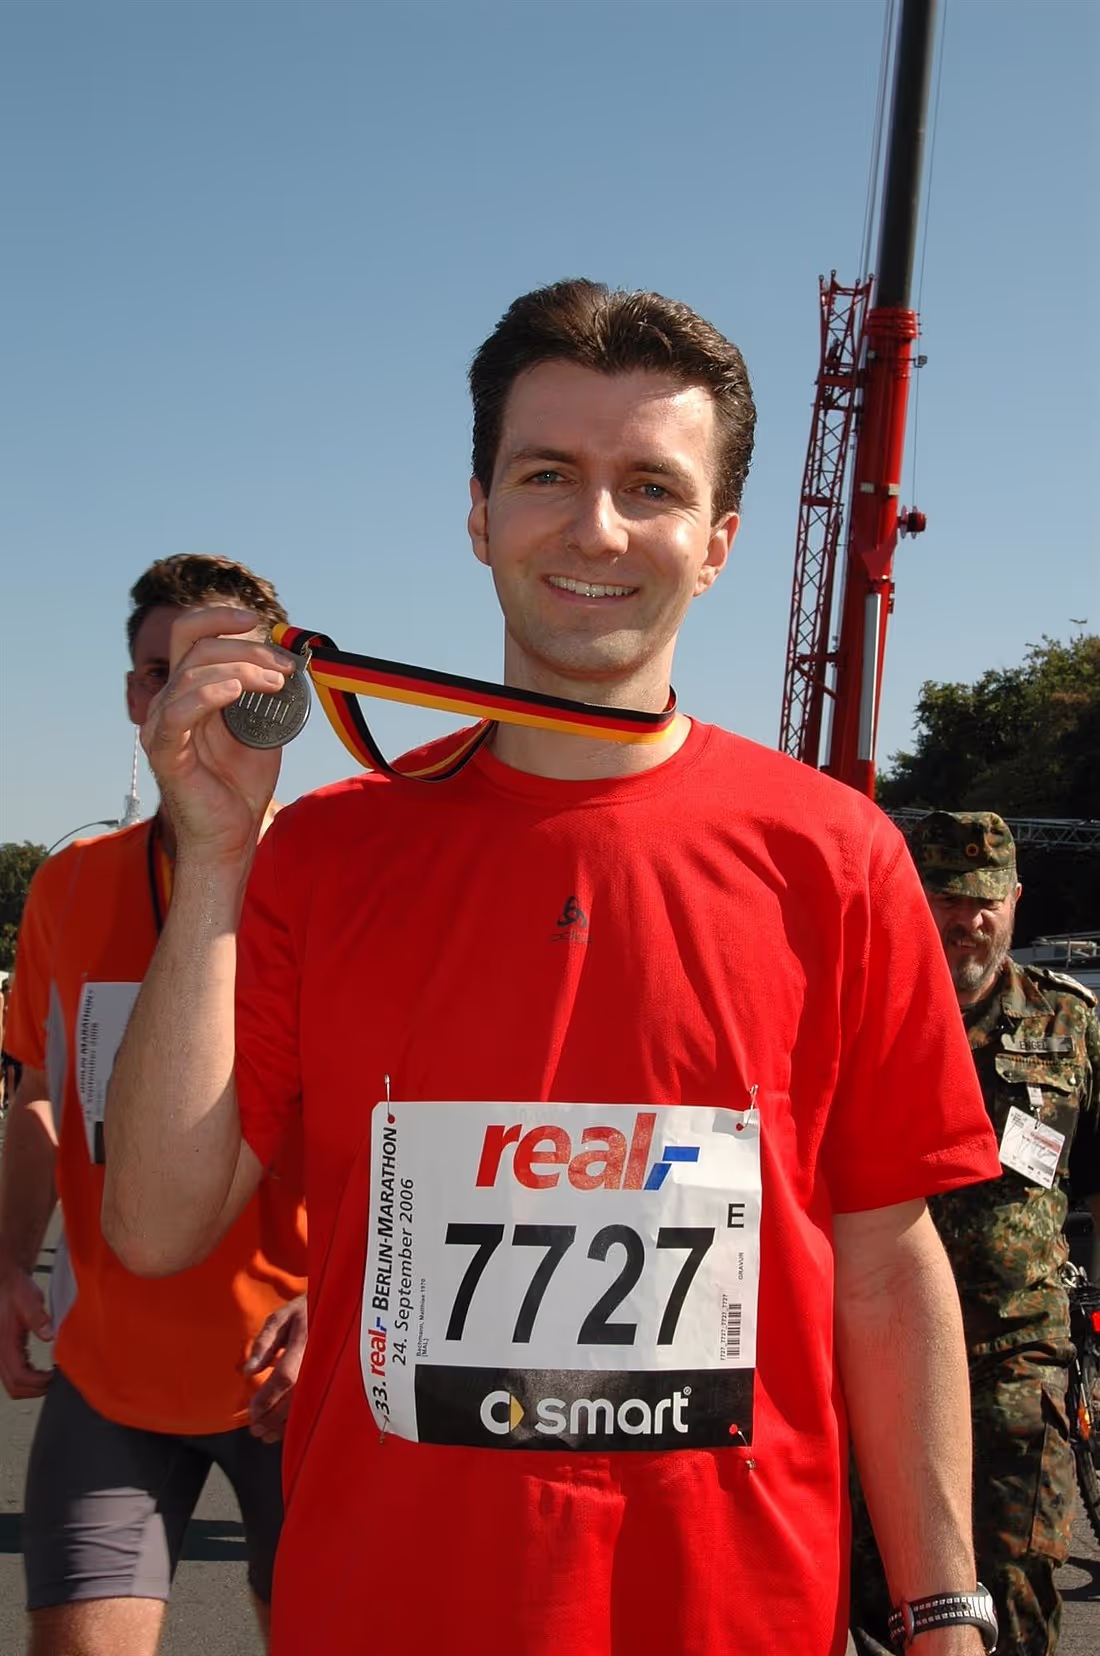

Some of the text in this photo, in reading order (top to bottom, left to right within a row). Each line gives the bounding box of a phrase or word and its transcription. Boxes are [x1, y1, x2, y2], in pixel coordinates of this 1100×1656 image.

[371, 1127, 397, 1311] BERLIN-MARATHON
[727, 1203, 745, 1228] E
[392, 1178, 414, 1366] 24. September 2006
[444, 1223, 716, 1346] 7727
[373, 1382, 390, 1415] 33.
[534, 1391, 690, 1435] smart
